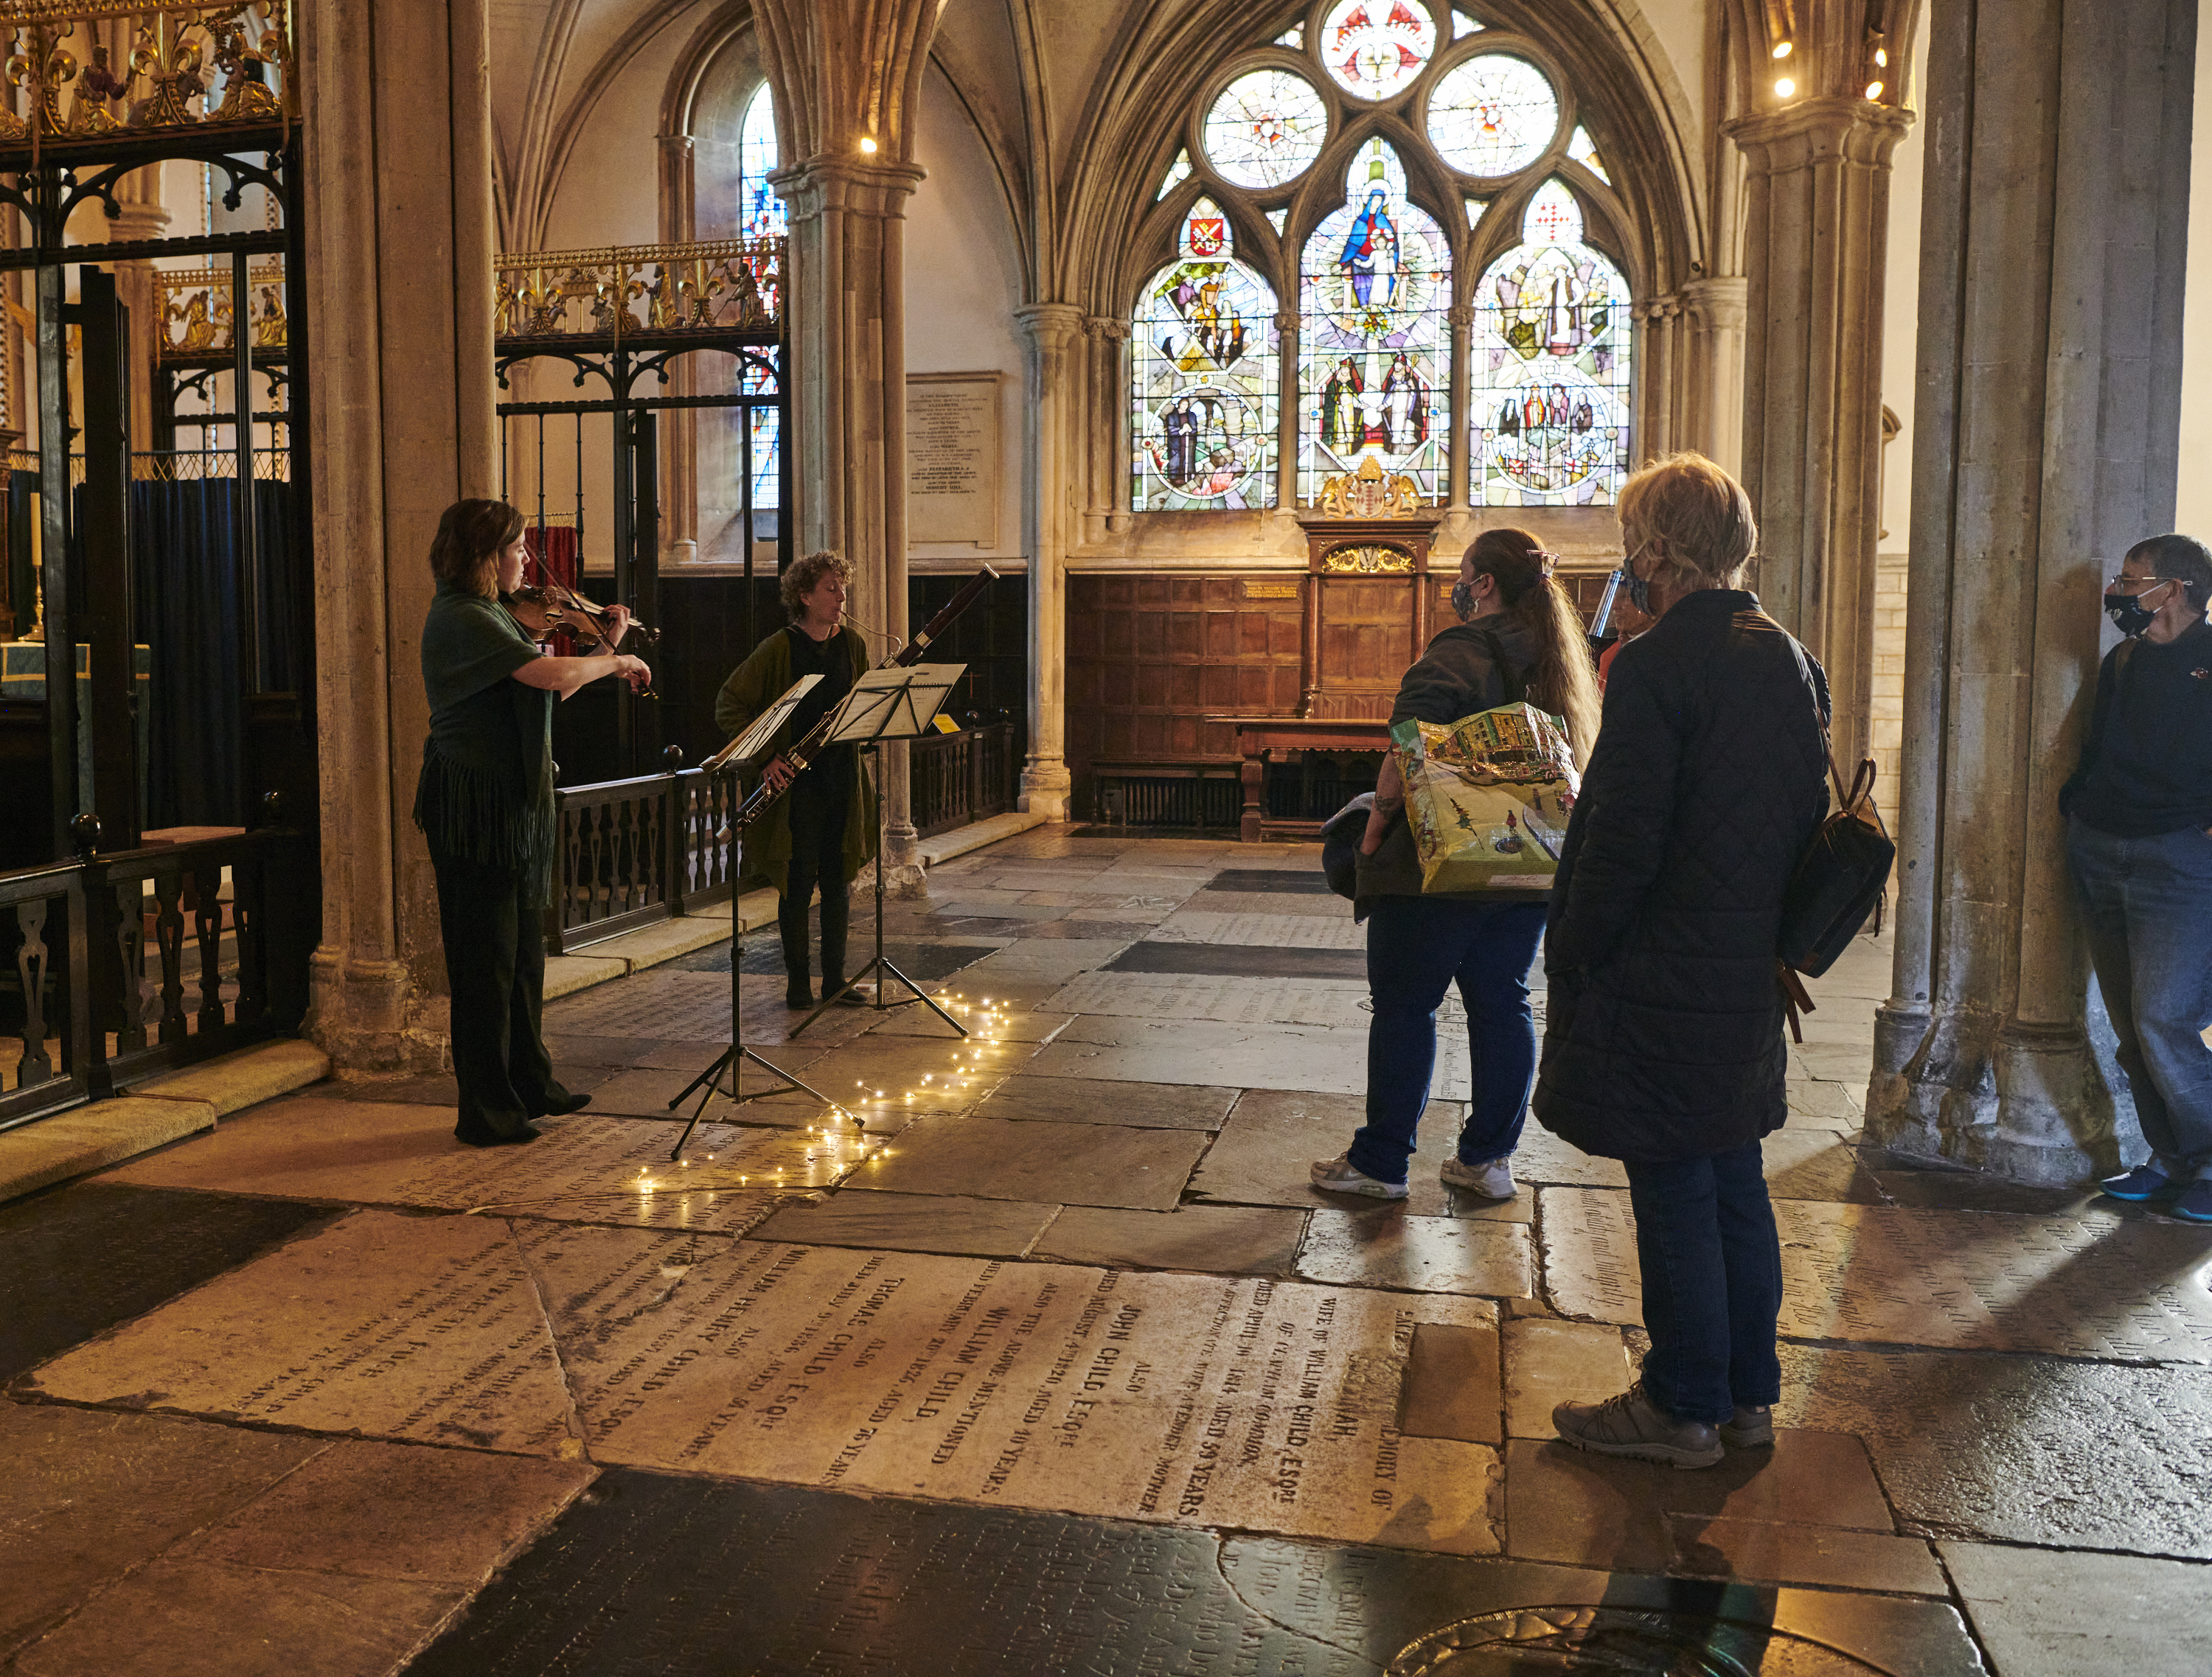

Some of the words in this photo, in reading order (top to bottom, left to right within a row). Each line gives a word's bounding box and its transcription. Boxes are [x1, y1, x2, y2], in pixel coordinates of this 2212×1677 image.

[1569, 1207, 1622, 1237] ability
[740, 1242, 779, 1263] DIED
[1589, 1236, 1620, 1257] and
[743, 1248, 810, 1293] WILLIAM
[848, 1256, 887, 1279] DIED
[973, 1260, 1006, 1281] DIED
[1093, 1269, 1123, 1292] DIED
[693, 1266, 753, 1305] JANUARY
[821, 1281, 863, 1307] JULY
[1029, 1282, 1062, 1308] ALSO
[1248, 1281, 1275, 1305] DIED
[1576, 1256, 1642, 1310] Integrity.
[473, 1303, 524, 1328] ALSO
[840, 1276, 906, 1327] THOMAS
[933, 1283, 990, 1334] FEBRUARY
[1312, 1297, 1338, 1325] WIFE
[1820, 1285, 1888, 1333] Parish
[690, 1297, 758, 1342] HENRY
[1011, 1311, 1044, 1336] THE
[1103, 1304, 1144, 1341] JOHN
[717, 1326, 765, 1356] ALSO
[949, 1306, 1012, 1364] WILLIAM
[1308, 1329, 1332, 1343] OF
[457, 1352, 511, 1380] AGED
[847, 1337, 891, 1368] ALSO
[601, 1356, 653, 1386] AGED
[740, 1359, 791, 1392] AGED
[1121, 1361, 1155, 1393] ALSO
[1295, 1349, 1327, 1400] WILLIAM
[864, 1389, 911, 1424] AGED
[1018, 1390, 1057, 1424] AGED
[1203, 1401, 1238, 1438] AGED
[850, 1426, 884, 1442] 76
[1006, 1427, 1036, 1445] 40
[1368, 1489, 1393, 1510] OF
